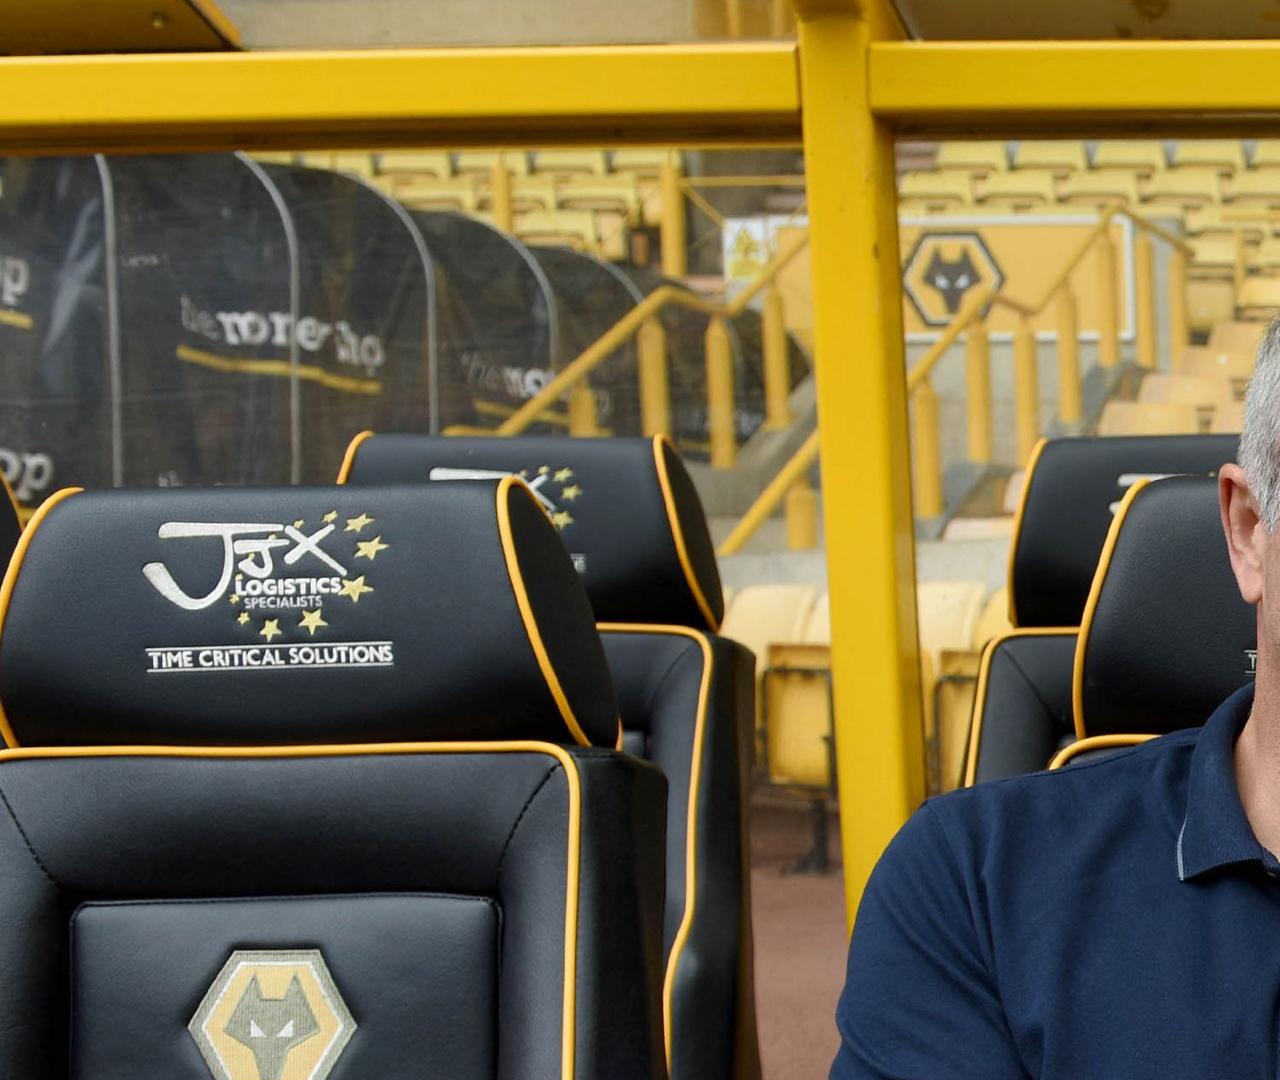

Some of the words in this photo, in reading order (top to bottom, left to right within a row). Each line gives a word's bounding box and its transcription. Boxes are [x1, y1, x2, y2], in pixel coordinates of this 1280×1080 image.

[235, 577, 342, 597] LOGISTICS
[244, 596, 323, 609] SPECIALISTS
[148, 651, 192, 669] TIME
[199, 649, 285, 668] CRITICAL
[289, 645, 394, 665] SOLUTIONS
